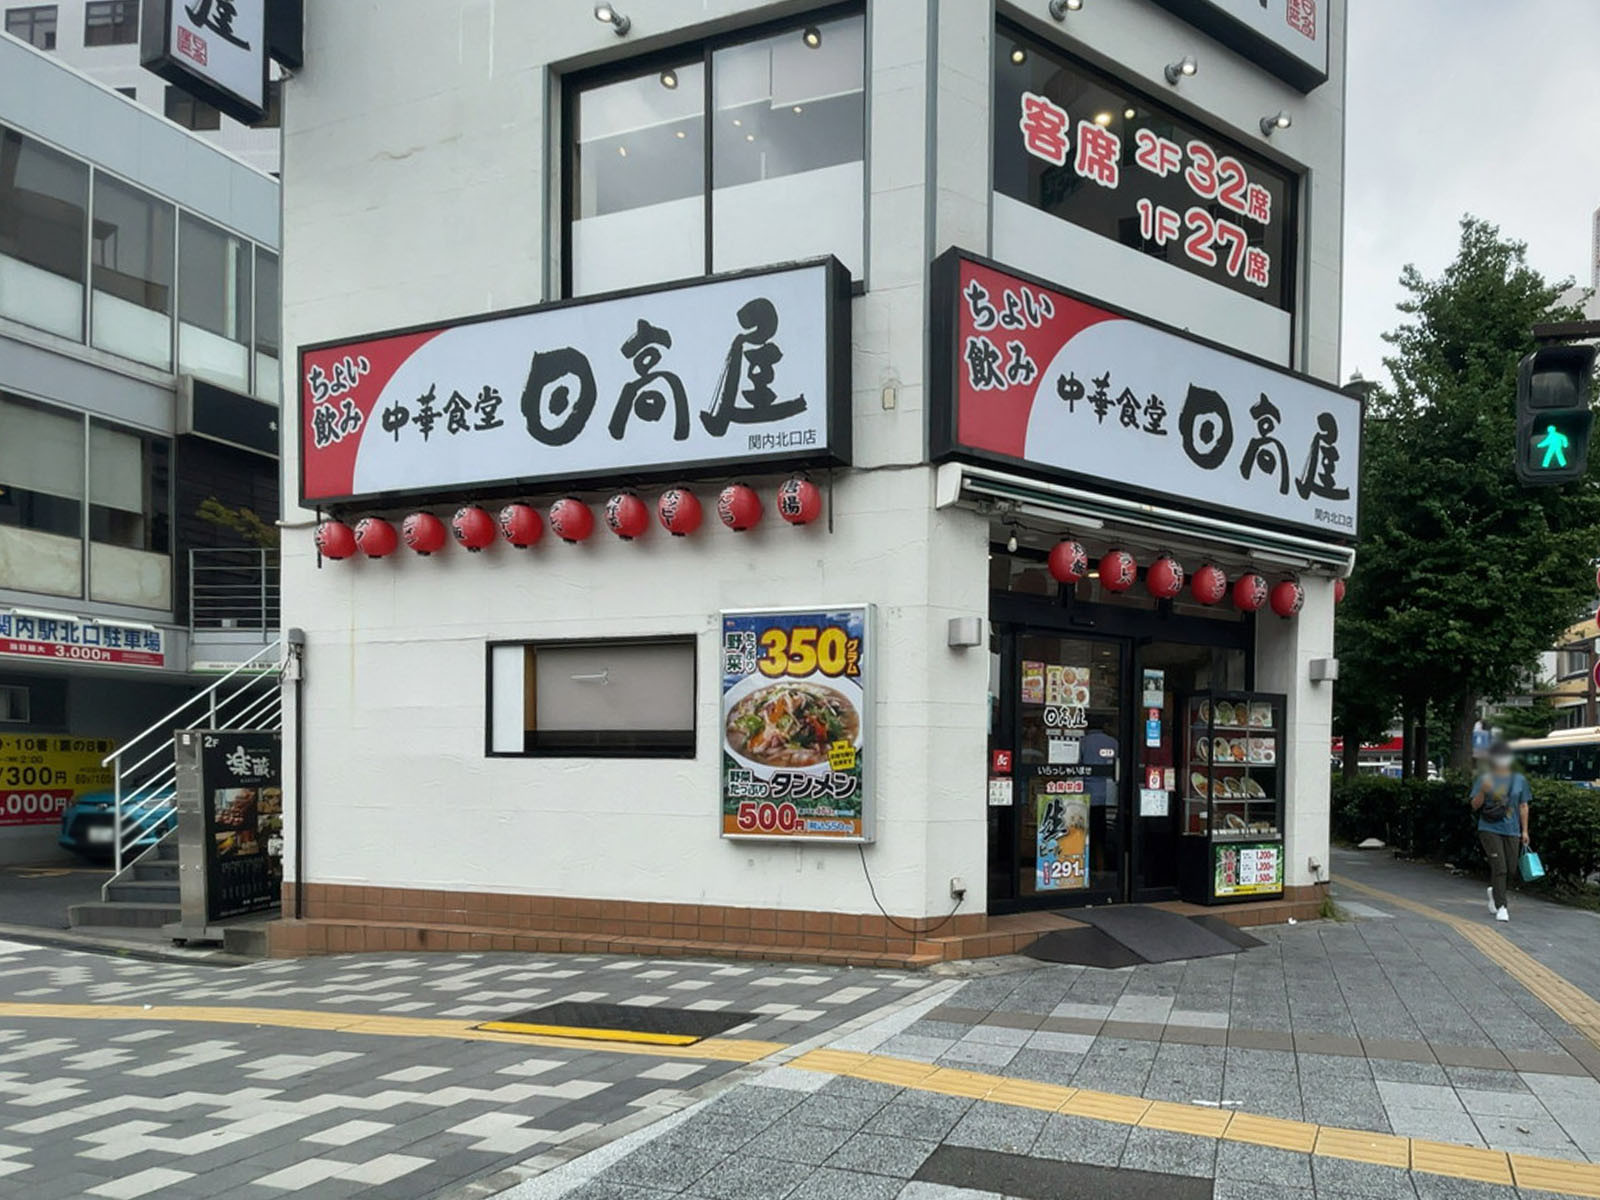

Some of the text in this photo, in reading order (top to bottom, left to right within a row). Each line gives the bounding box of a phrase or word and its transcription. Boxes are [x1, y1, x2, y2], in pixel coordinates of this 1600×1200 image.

[1021, 92, 1272, 225] 客席 2F 32席
[1137, 199, 1270, 287] 1F 27席
[963, 279, 1055, 331] ちょい
[307, 356, 370, 403] ちょい
[382, 298, 807, 446] 中華食堂 日高屋
[964, 336, 1038, 391] 飲み
[312, 398, 364, 449] 飲み
[748, 430, 817, 450] 関内北口店
[1057, 371, 1350, 500] 中華食堂 日高屋
[1314, 508, 1353, 528] 関内北口店
[726, 632, 743, 673] 野菜
[757, 627, 848, 677] 350
[847, 638, 859, 675] グラム
[204, 736, 219, 748] 2F
[771, 772, 857, 798] タンメン
[738, 802, 805, 832] 500円
